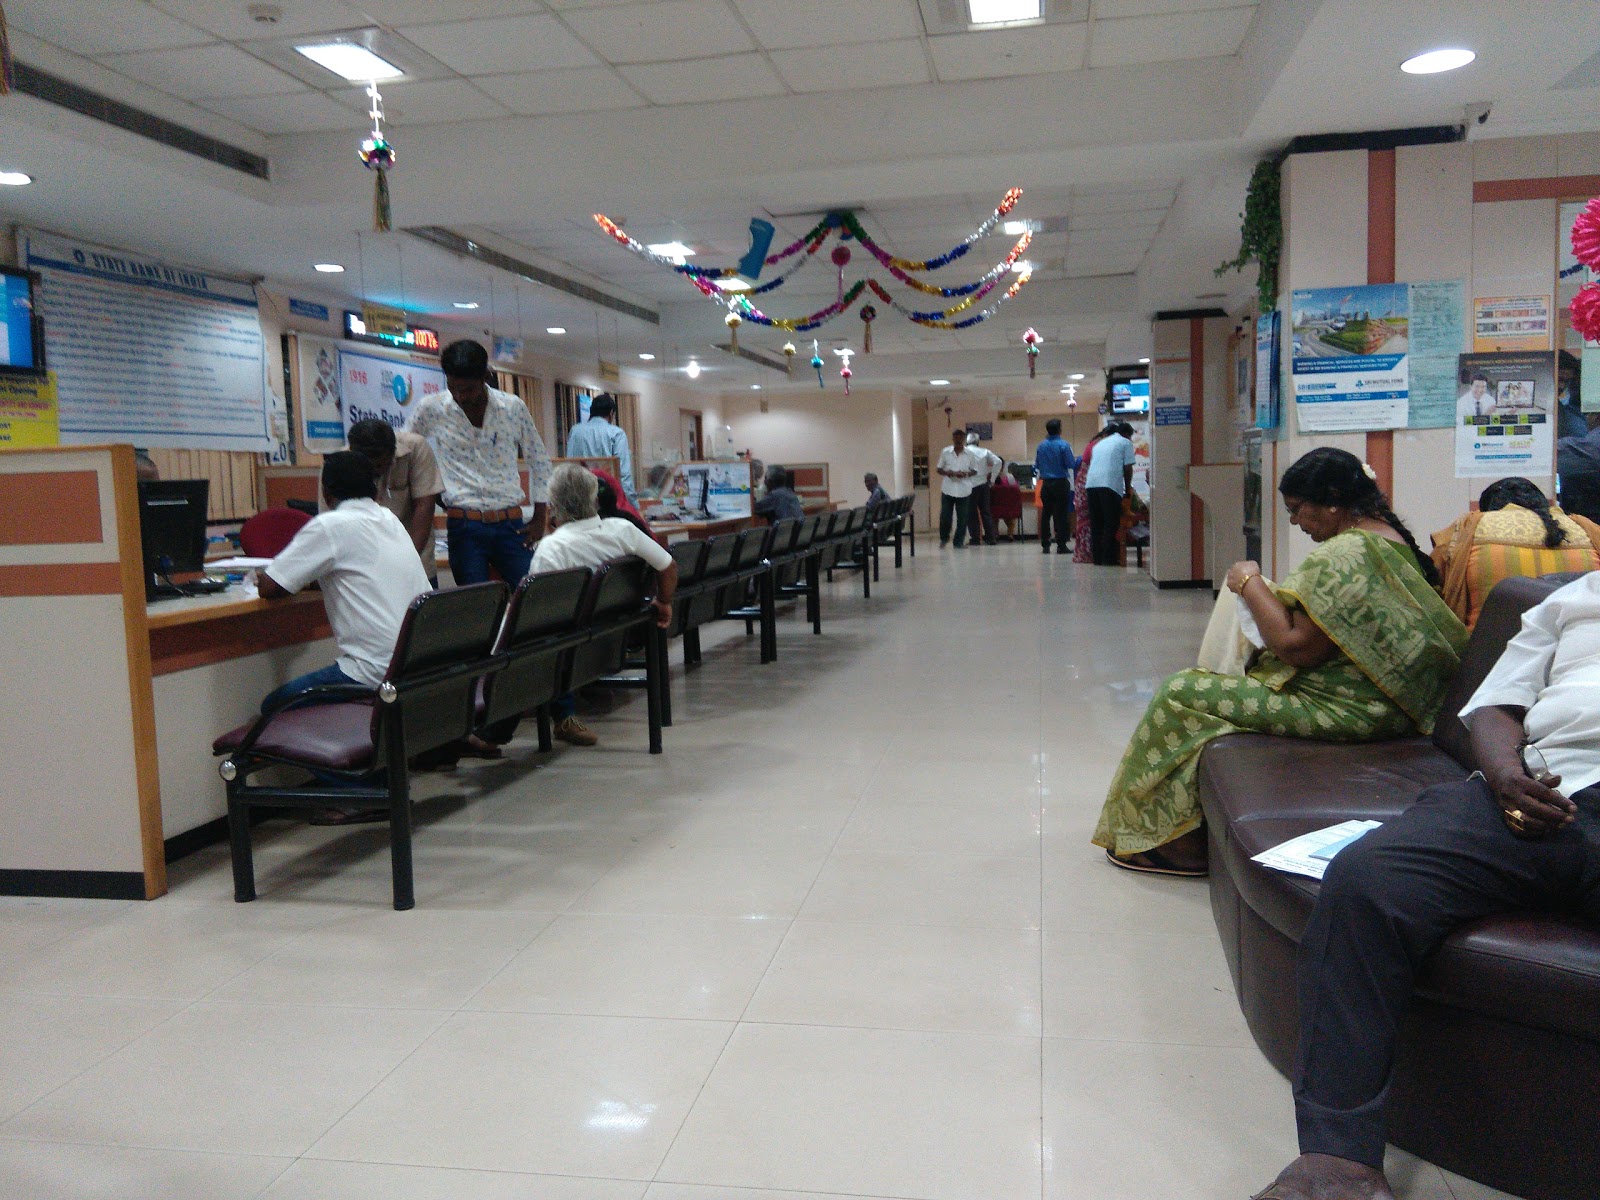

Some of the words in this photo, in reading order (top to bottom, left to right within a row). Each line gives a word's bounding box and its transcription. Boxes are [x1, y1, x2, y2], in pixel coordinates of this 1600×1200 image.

[91, 252, 128, 274] STATE
[129, 260, 162, 281] BANK
[163, 265, 177, 285] OF
[178, 271, 208, 290] INDIA
[349, 369, 368, 385] 1916
[381, 409, 406, 429] Bank
